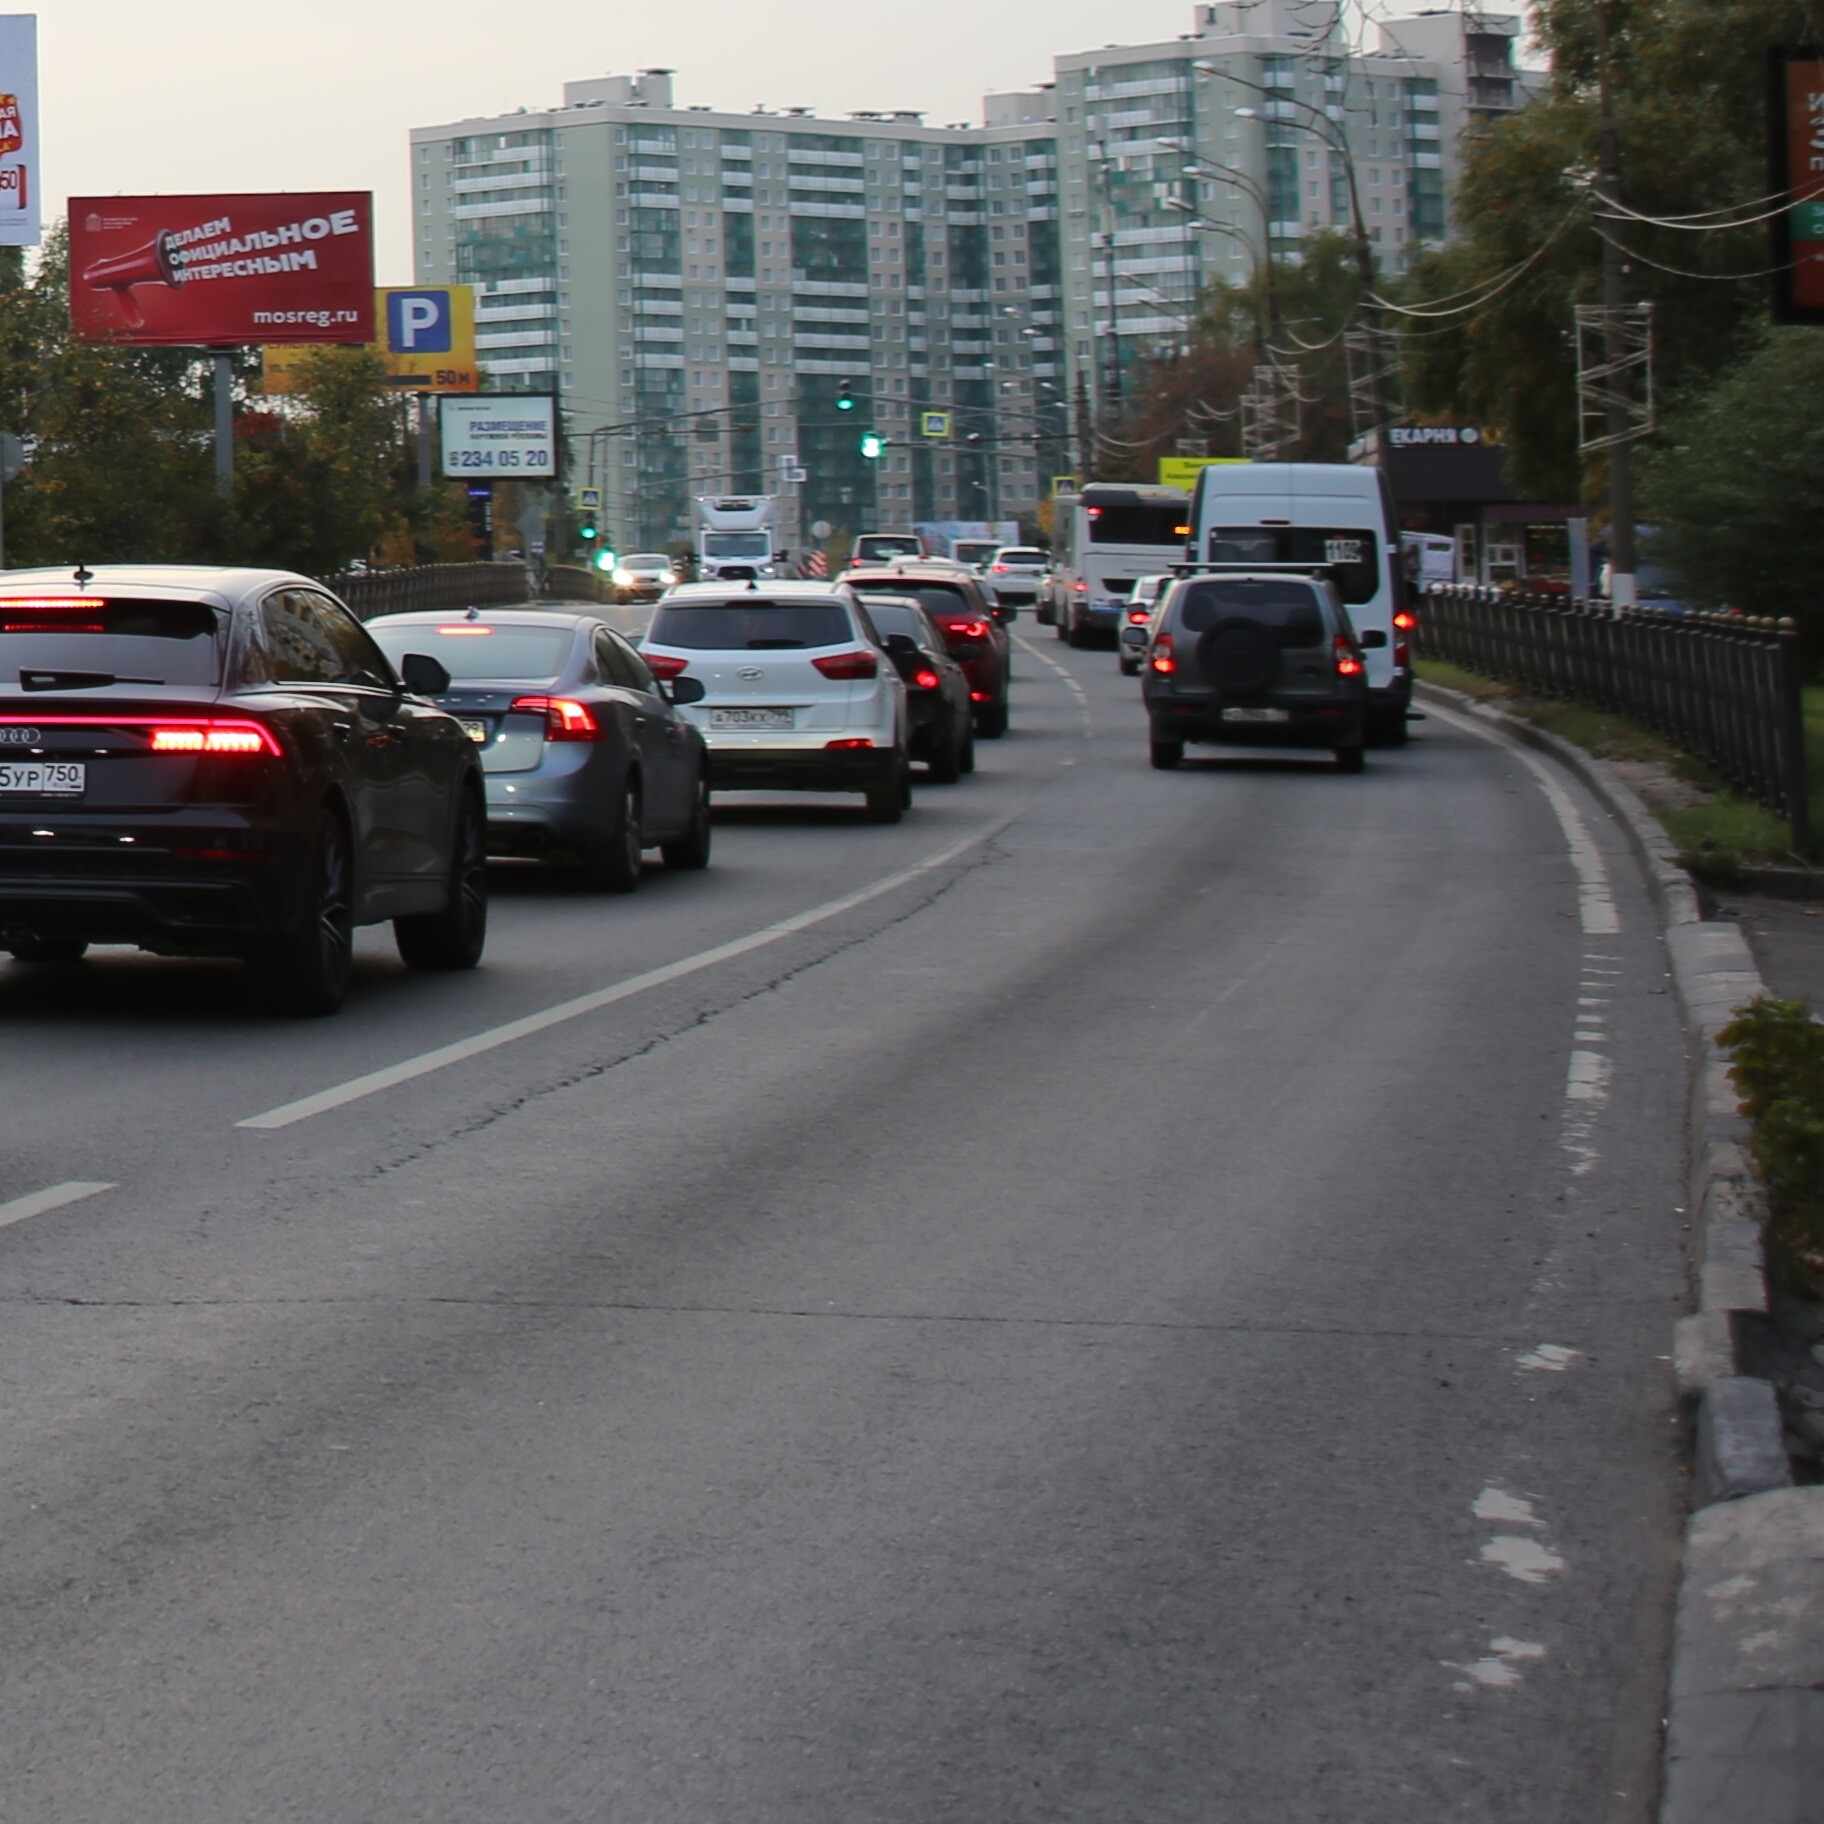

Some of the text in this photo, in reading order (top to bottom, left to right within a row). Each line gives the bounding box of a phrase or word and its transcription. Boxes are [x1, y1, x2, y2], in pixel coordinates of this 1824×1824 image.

[164, 217, 232, 250] ДЕЛАЕМ
[168, 208, 359, 265] ОФИЦИАЛЬНОЕ
[172, 249, 318, 282] ИНТЕРЕСНЫМ
[253, 308, 358, 327] mosreg.ru
[461, 450, 494, 467] 234
[499, 450, 520, 467] 05
[525, 450, 548, 467] 20
[45, 765, 79, 782] 750
